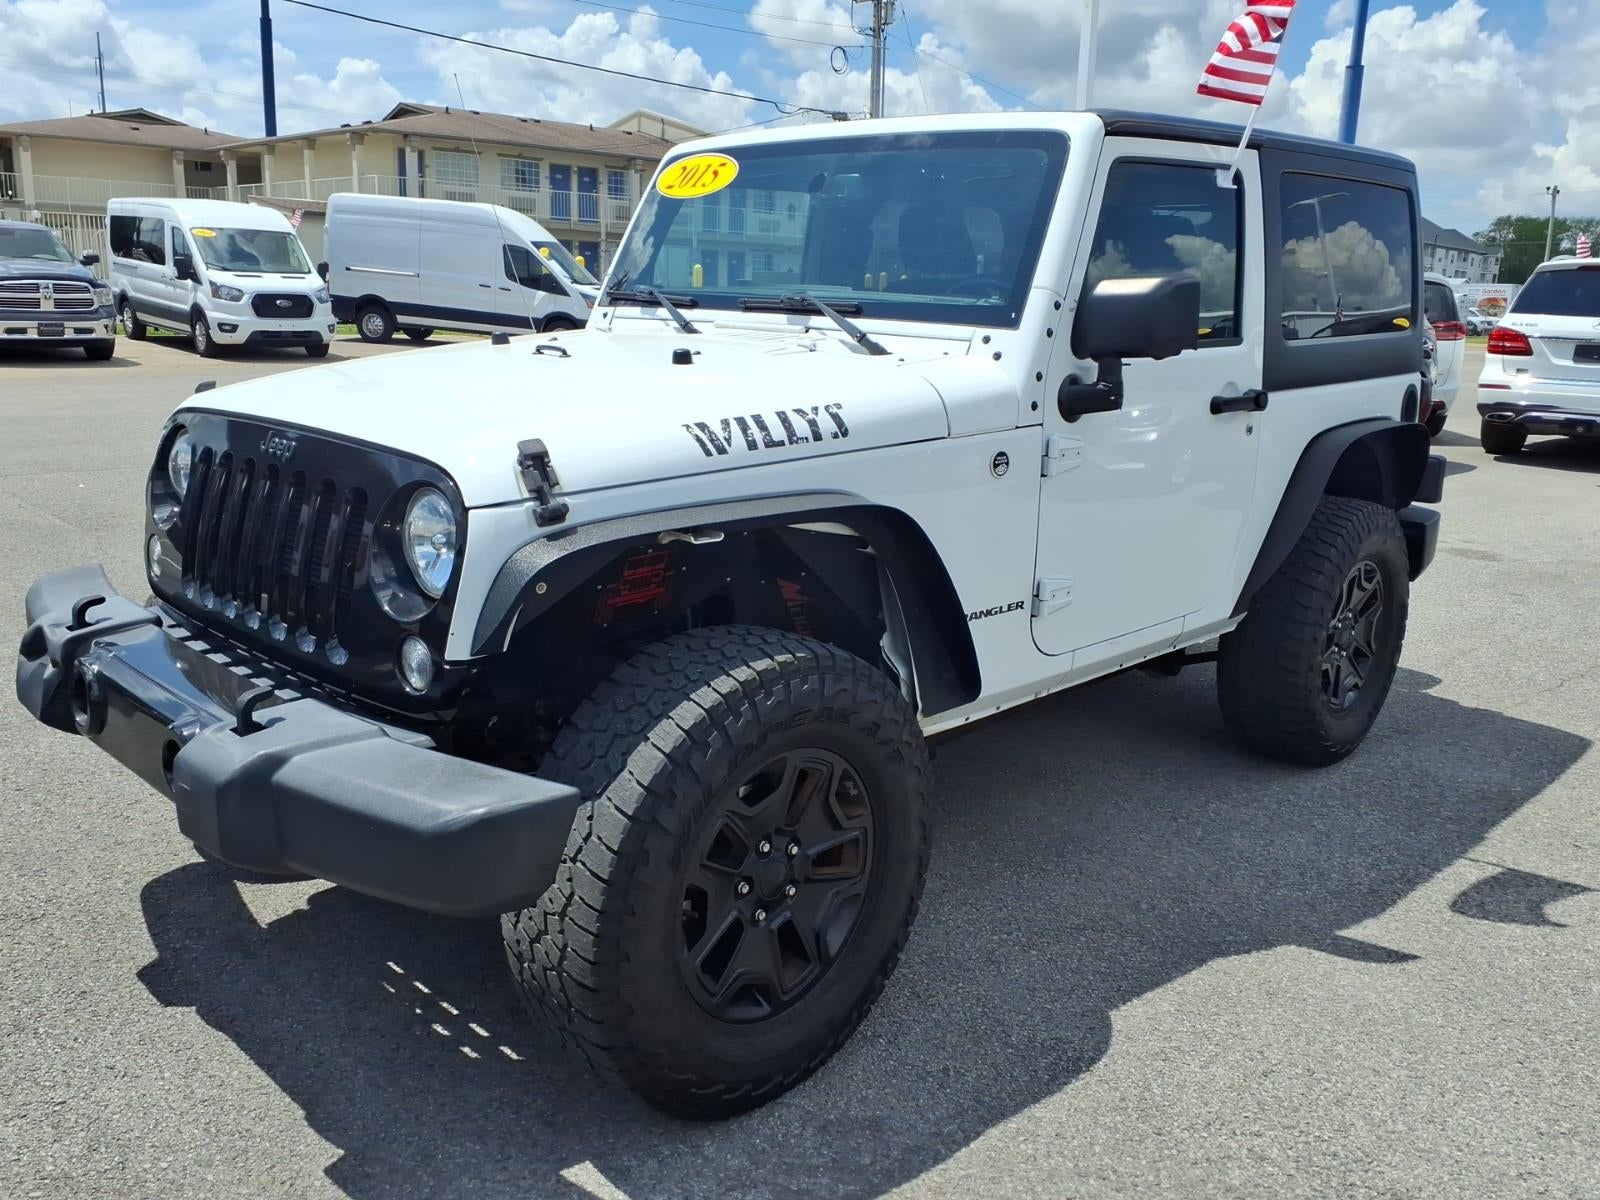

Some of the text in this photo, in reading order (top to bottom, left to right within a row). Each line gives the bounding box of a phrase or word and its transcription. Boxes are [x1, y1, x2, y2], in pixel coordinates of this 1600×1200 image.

[665, 162, 728, 189] 2015
[681, 402, 849, 457] WILLYS
[260, 430, 297, 462] Jeep
